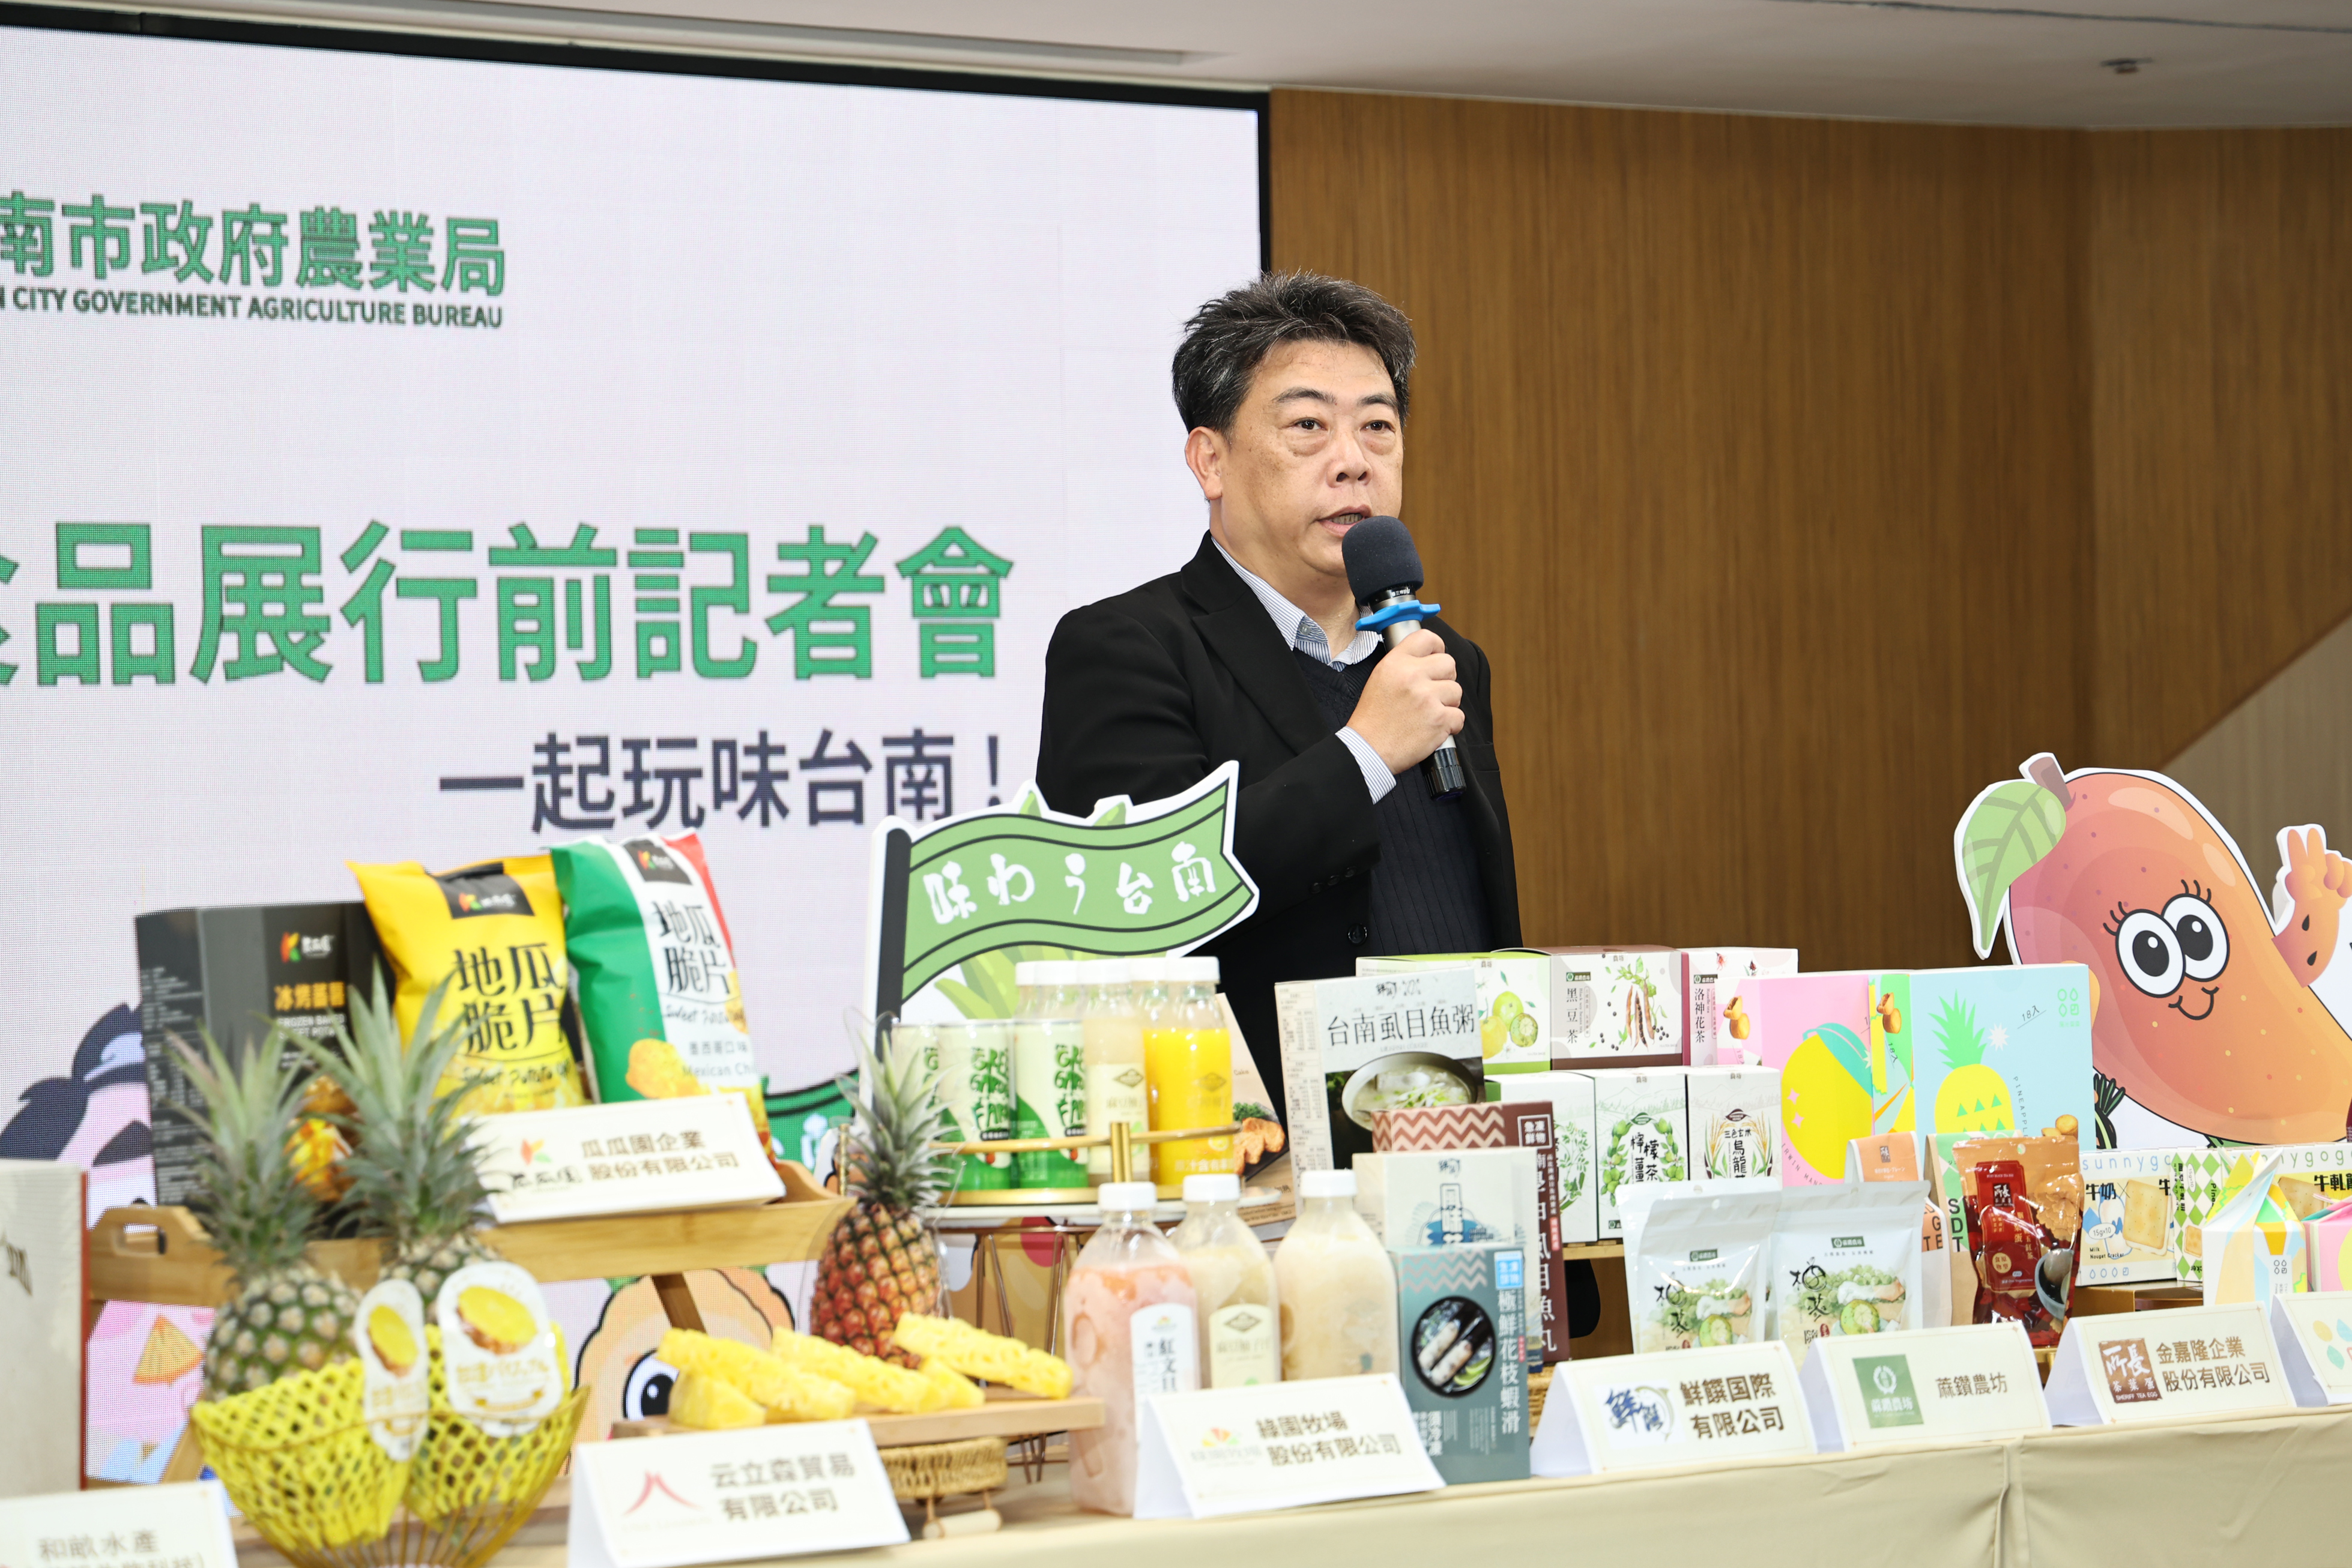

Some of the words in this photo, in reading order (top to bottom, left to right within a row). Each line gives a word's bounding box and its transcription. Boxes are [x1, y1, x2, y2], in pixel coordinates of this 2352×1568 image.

[0, 189, 505, 296] 南市政府農業局
[12, 287, 68, 312] CITY
[73, 289, 241, 319] GOVERNMENT
[247, 297, 406, 325] AGRICULTURE
[413, 305, 503, 328] BUREAU
[0, 521, 1014, 686] 品展行前記者會
[922, 842, 1217, 924] 味わう台南
[652, 900, 722, 948] 地瓜
[453, 942, 563, 997] 地瓜
[664, 945, 731, 995] 脆片
[462, 992, 563, 1054] 脆片
[1328, 1003, 1475, 1046] 台南虱目魚粥
[1566, 988, 1578, 1044] 黑豆茶
[1694, 988, 1705, 1043] 洛神花茶
[2021, 1005, 2040, 1022] 18入
[582, 1130, 706, 1159] 瓜瓜園企業
[1781, 1142, 1801, 1171] IRWIN
[588, 1151, 740, 1181] 股份有限公司
[2086, 1183, 2117, 1201] 牛奶
[1497, 1290, 1521, 1435] 極鮮花枝蝦滑
[2102, 1343, 2151, 1377] 所長
[2156, 1336, 2246, 1364] 金嘉隆企業
[2112, 1377, 2156, 1392] 茶葉蛋
[2162, 1361, 2270, 1393] 股份有限公司
[1690, 1406, 1785, 1440] 有限公司
[1267, 1434, 1401, 1467] 股份有限公司
[712, 1453, 855, 1489] 云立森貿易
[720, 1488, 839, 1521] 有限公司
